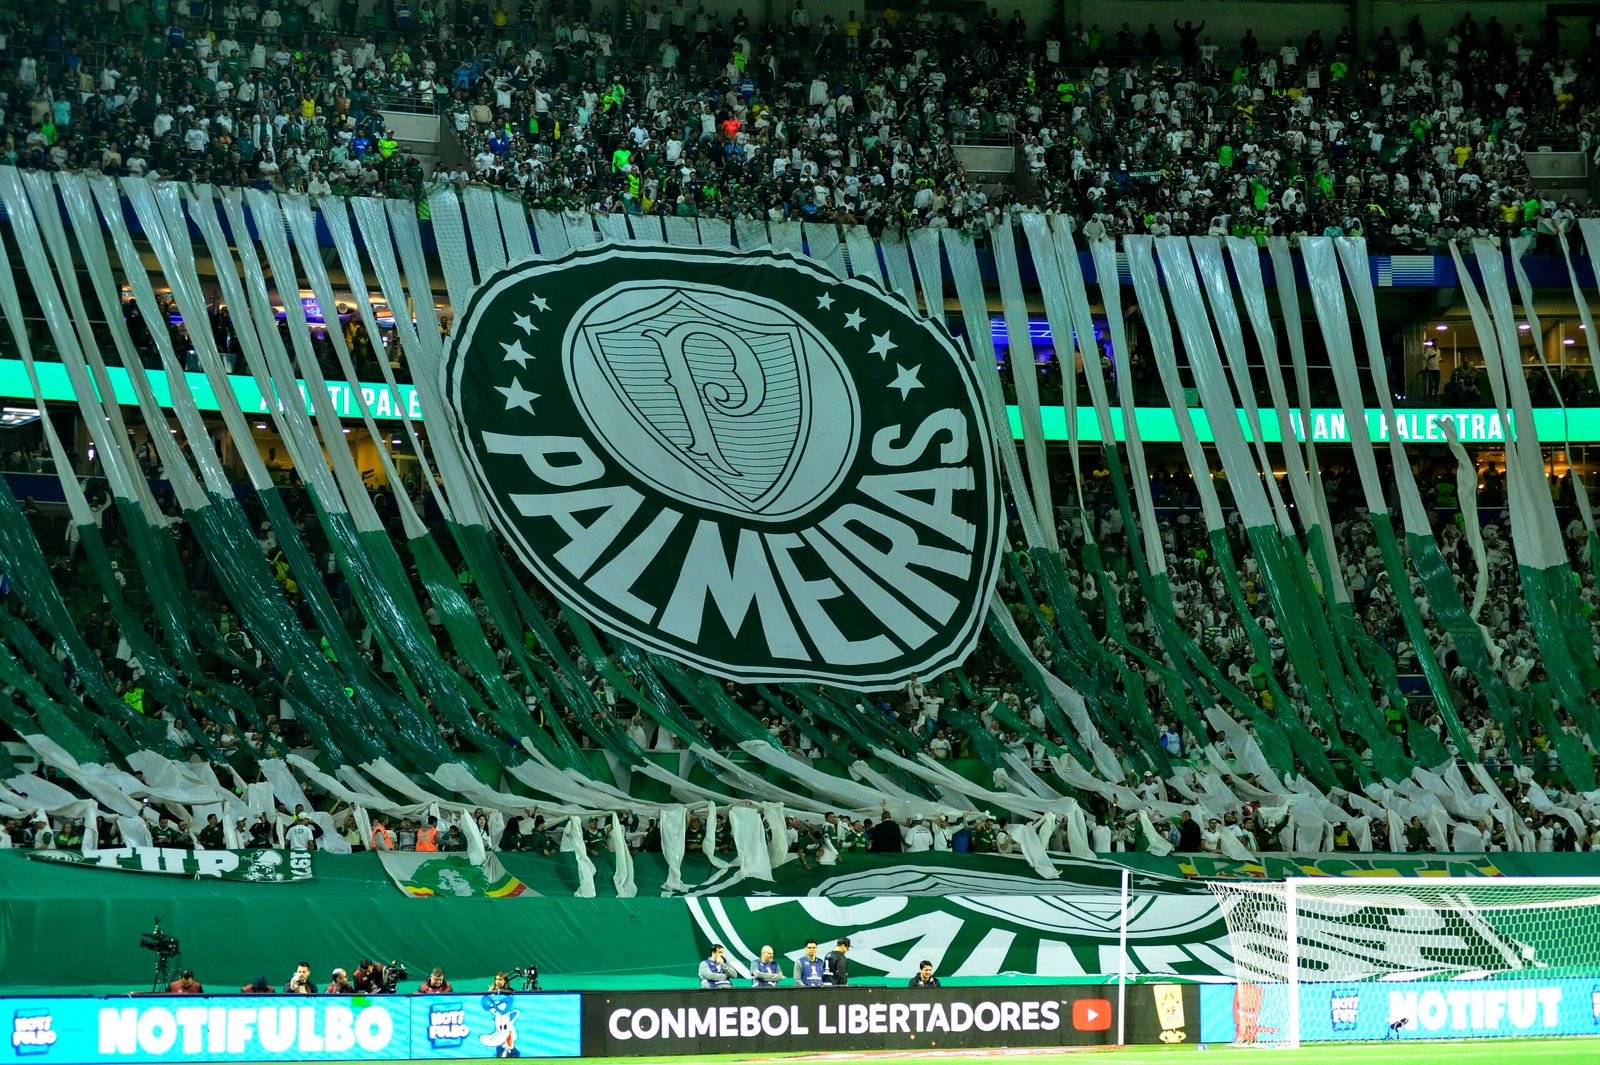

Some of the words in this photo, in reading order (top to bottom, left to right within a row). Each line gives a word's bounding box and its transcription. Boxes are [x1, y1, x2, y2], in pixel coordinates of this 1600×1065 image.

[481, 408, 977, 666] PALMEIRAS
[98, 1006, 394, 1055] NOTIFULBO
[608, 1005, 809, 1041] CONMEBOL
[819, 1000, 1061, 1035] LIBERTADORES
[1388, 987, 1562, 1031] NOTIFUT
